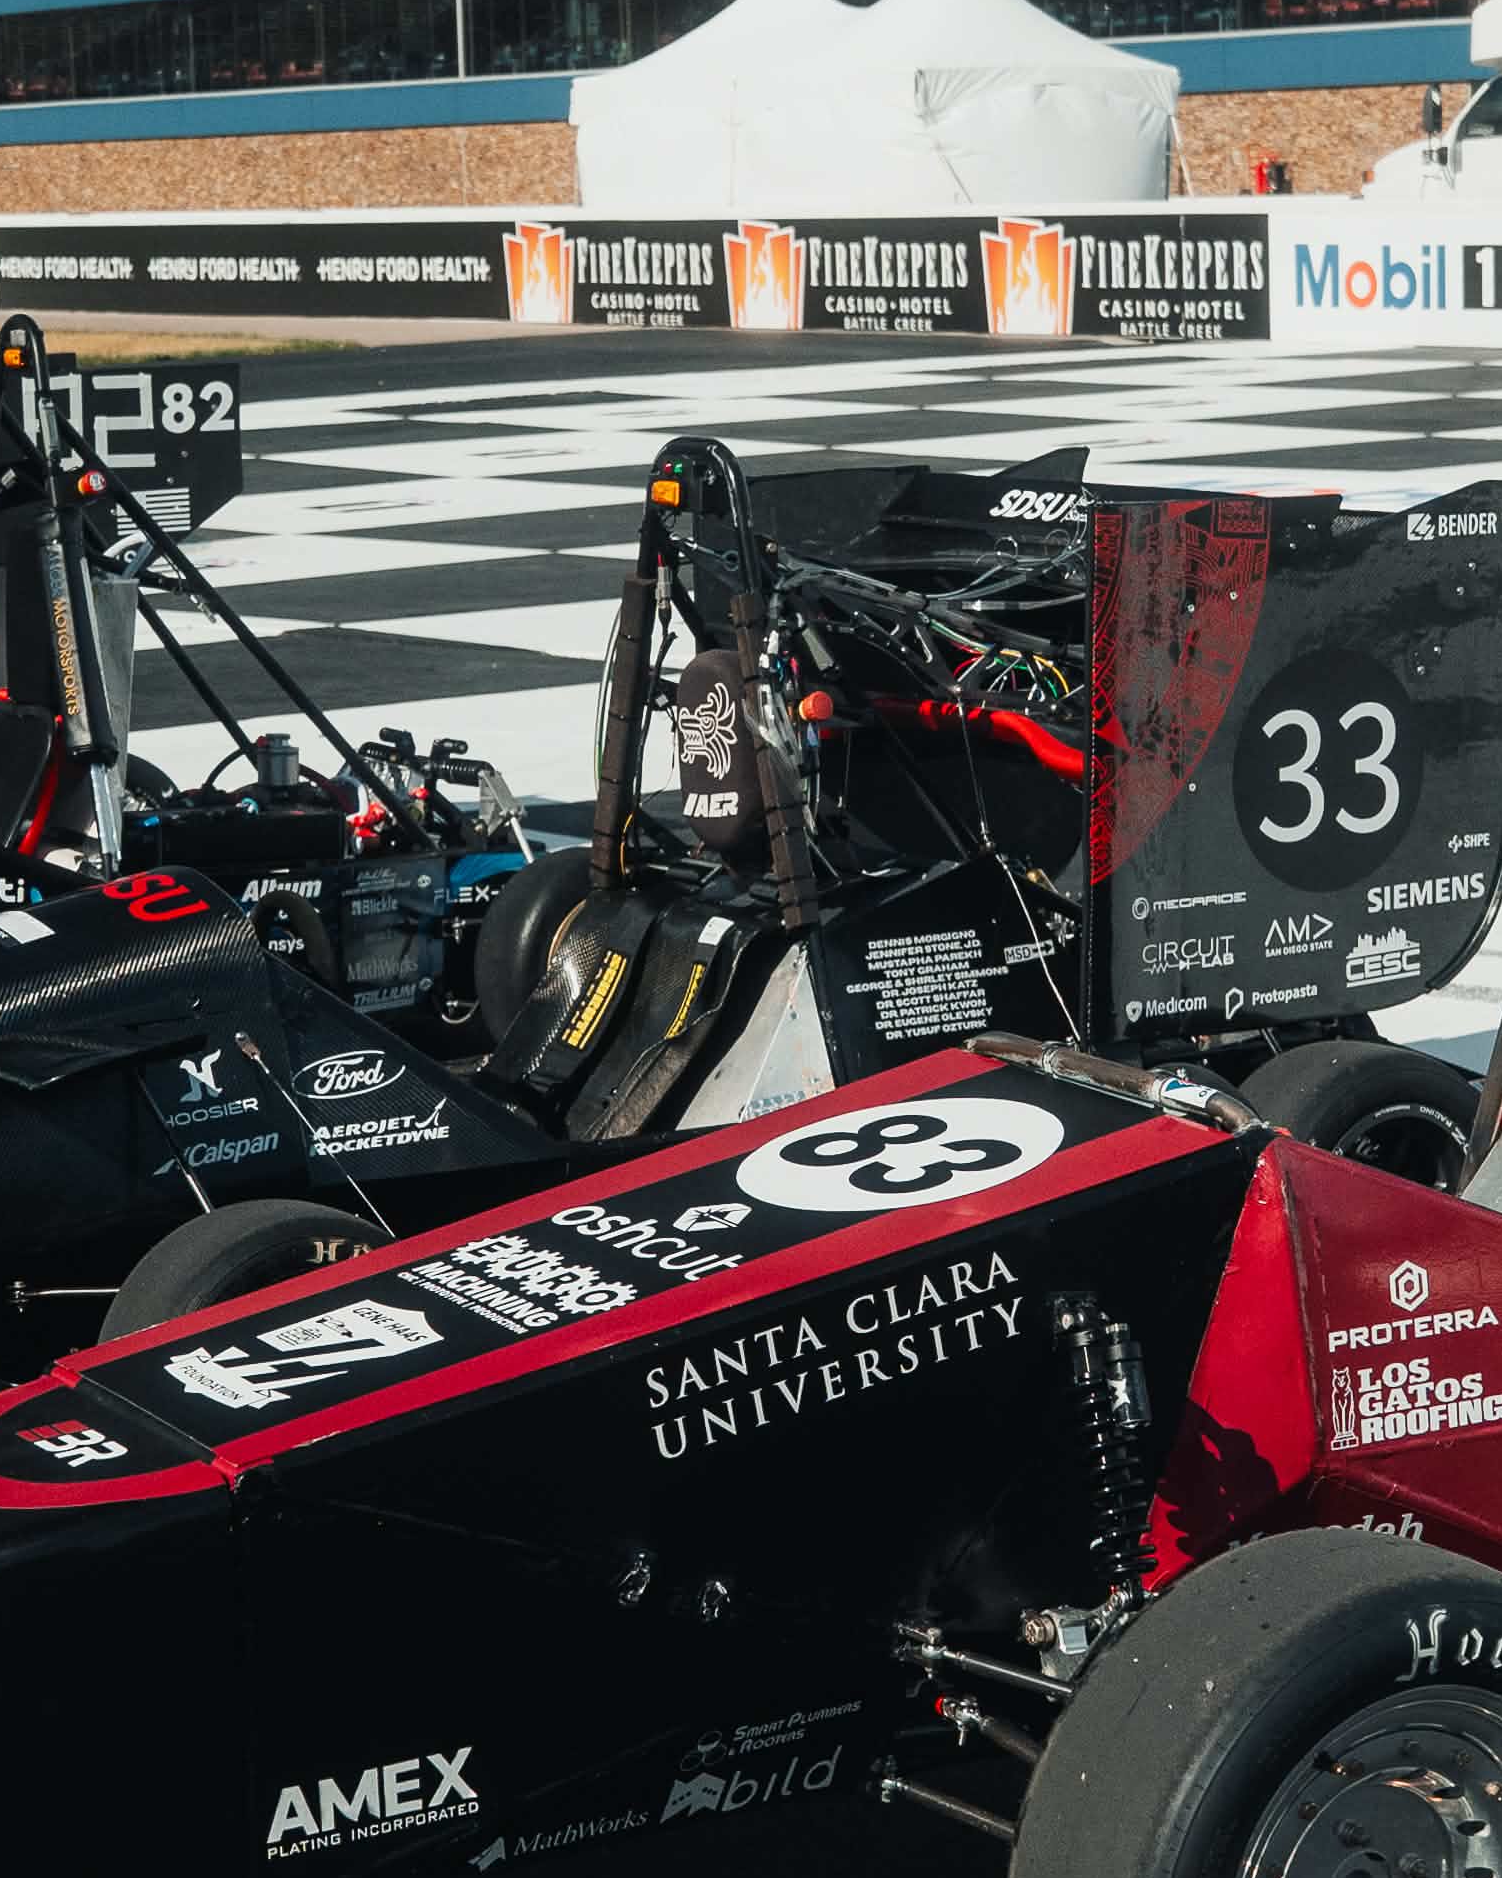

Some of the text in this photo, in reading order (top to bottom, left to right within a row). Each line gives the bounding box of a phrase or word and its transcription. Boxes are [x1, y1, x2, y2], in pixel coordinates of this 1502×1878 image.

[44, 256, 77, 279] FORD
[79, 256, 133, 279] HEALTH
[148, 257, 299, 281] HENRY FORD HEALTH
[316, 257, 491, 282] HENRY FORD HEALTH
[1295, 244, 1446, 309] Mobil
[591, 291, 700, 312] CASINO HOTEL
[825, 296, 953, 316] CASINO HOTEL
[1099, 299, 1245, 321] CASINO HOTEL
[607, 312, 683, 327] BATTLE CREEK
[843, 316, 933, 332] BATTLE CREEK
[1120, 322, 1222, 339] BATTLE CREEK
[161, 380, 235, 434] 82
[989, 489, 1077, 522] SDSU
[1437, 512, 1498, 537] BENDER
[53, 595, 80, 716] MOTORSPORTS
[1259, 701, 1400, 843] 33
[1463, 832, 1491, 848] SHPE
[1367, 872, 1486, 914] SIEMENS
[865, 945, 924, 961] JENNIFER
[868, 936, 913, 950] DENNIS
[1005, 945, 1032, 963] MSD
[1142, 935, 1235, 964] CIRCUIT
[1265, 945, 1287, 958] SAN
[1310, 939, 1334, 954] STATE
[868, 949, 982, 971] MUSTAPHA PAREKH
[883, 960, 970, 979] TONY GRAHAM
[1201, 952, 1235, 970] LAB
[1346, 948, 1420, 982] CESC
[846, 965, 1009, 994] GEORGE & SHIRLEY SIMMONS
[901, 978, 978, 997] JOSEPH KATZ
[896, 988, 986, 1008] SCOTT SHAFFAR
[899, 998, 987, 1018] PATRICK KWON
[1145, 993, 1207, 1019] Medicom
[1251, 982, 1319, 1007] Protopasta
[894, 1006, 993, 1028] EUGENE OLEVSKY
[905, 1018, 986, 1038] YUSUF OZTURK
[313, 1057, 386, 1096] Ford
[309, 1125, 450, 1156] ROCKETDYNE
[313, 1114, 416, 1141] AEROJET
[186, 1130, 280, 1168] Calspan
[779, 1114, 1023, 1194] 83
[463, 1240, 619, 1307] EURO
[411, 1260, 560, 1328] MACHINING
[352, 1306, 428, 1343] GENE HAAS
[646, 1251, 1019, 1410] SANTA CLARA
[1328, 1305, 1499, 1353] PROTERRA
[180, 1364, 243, 1402] FOUNDATION
[652, 1296, 1025, 1460] UNIVERSITY
[1358, 1357, 1431, 1393] LOS
[1358, 1372, 1484, 1418] GATOS
[266, 1746, 479, 1844] AMEX
[267, 1800, 480, 1860] PLATING INCORPORATED
[513, 1809, 649, 1857] MathWorks
